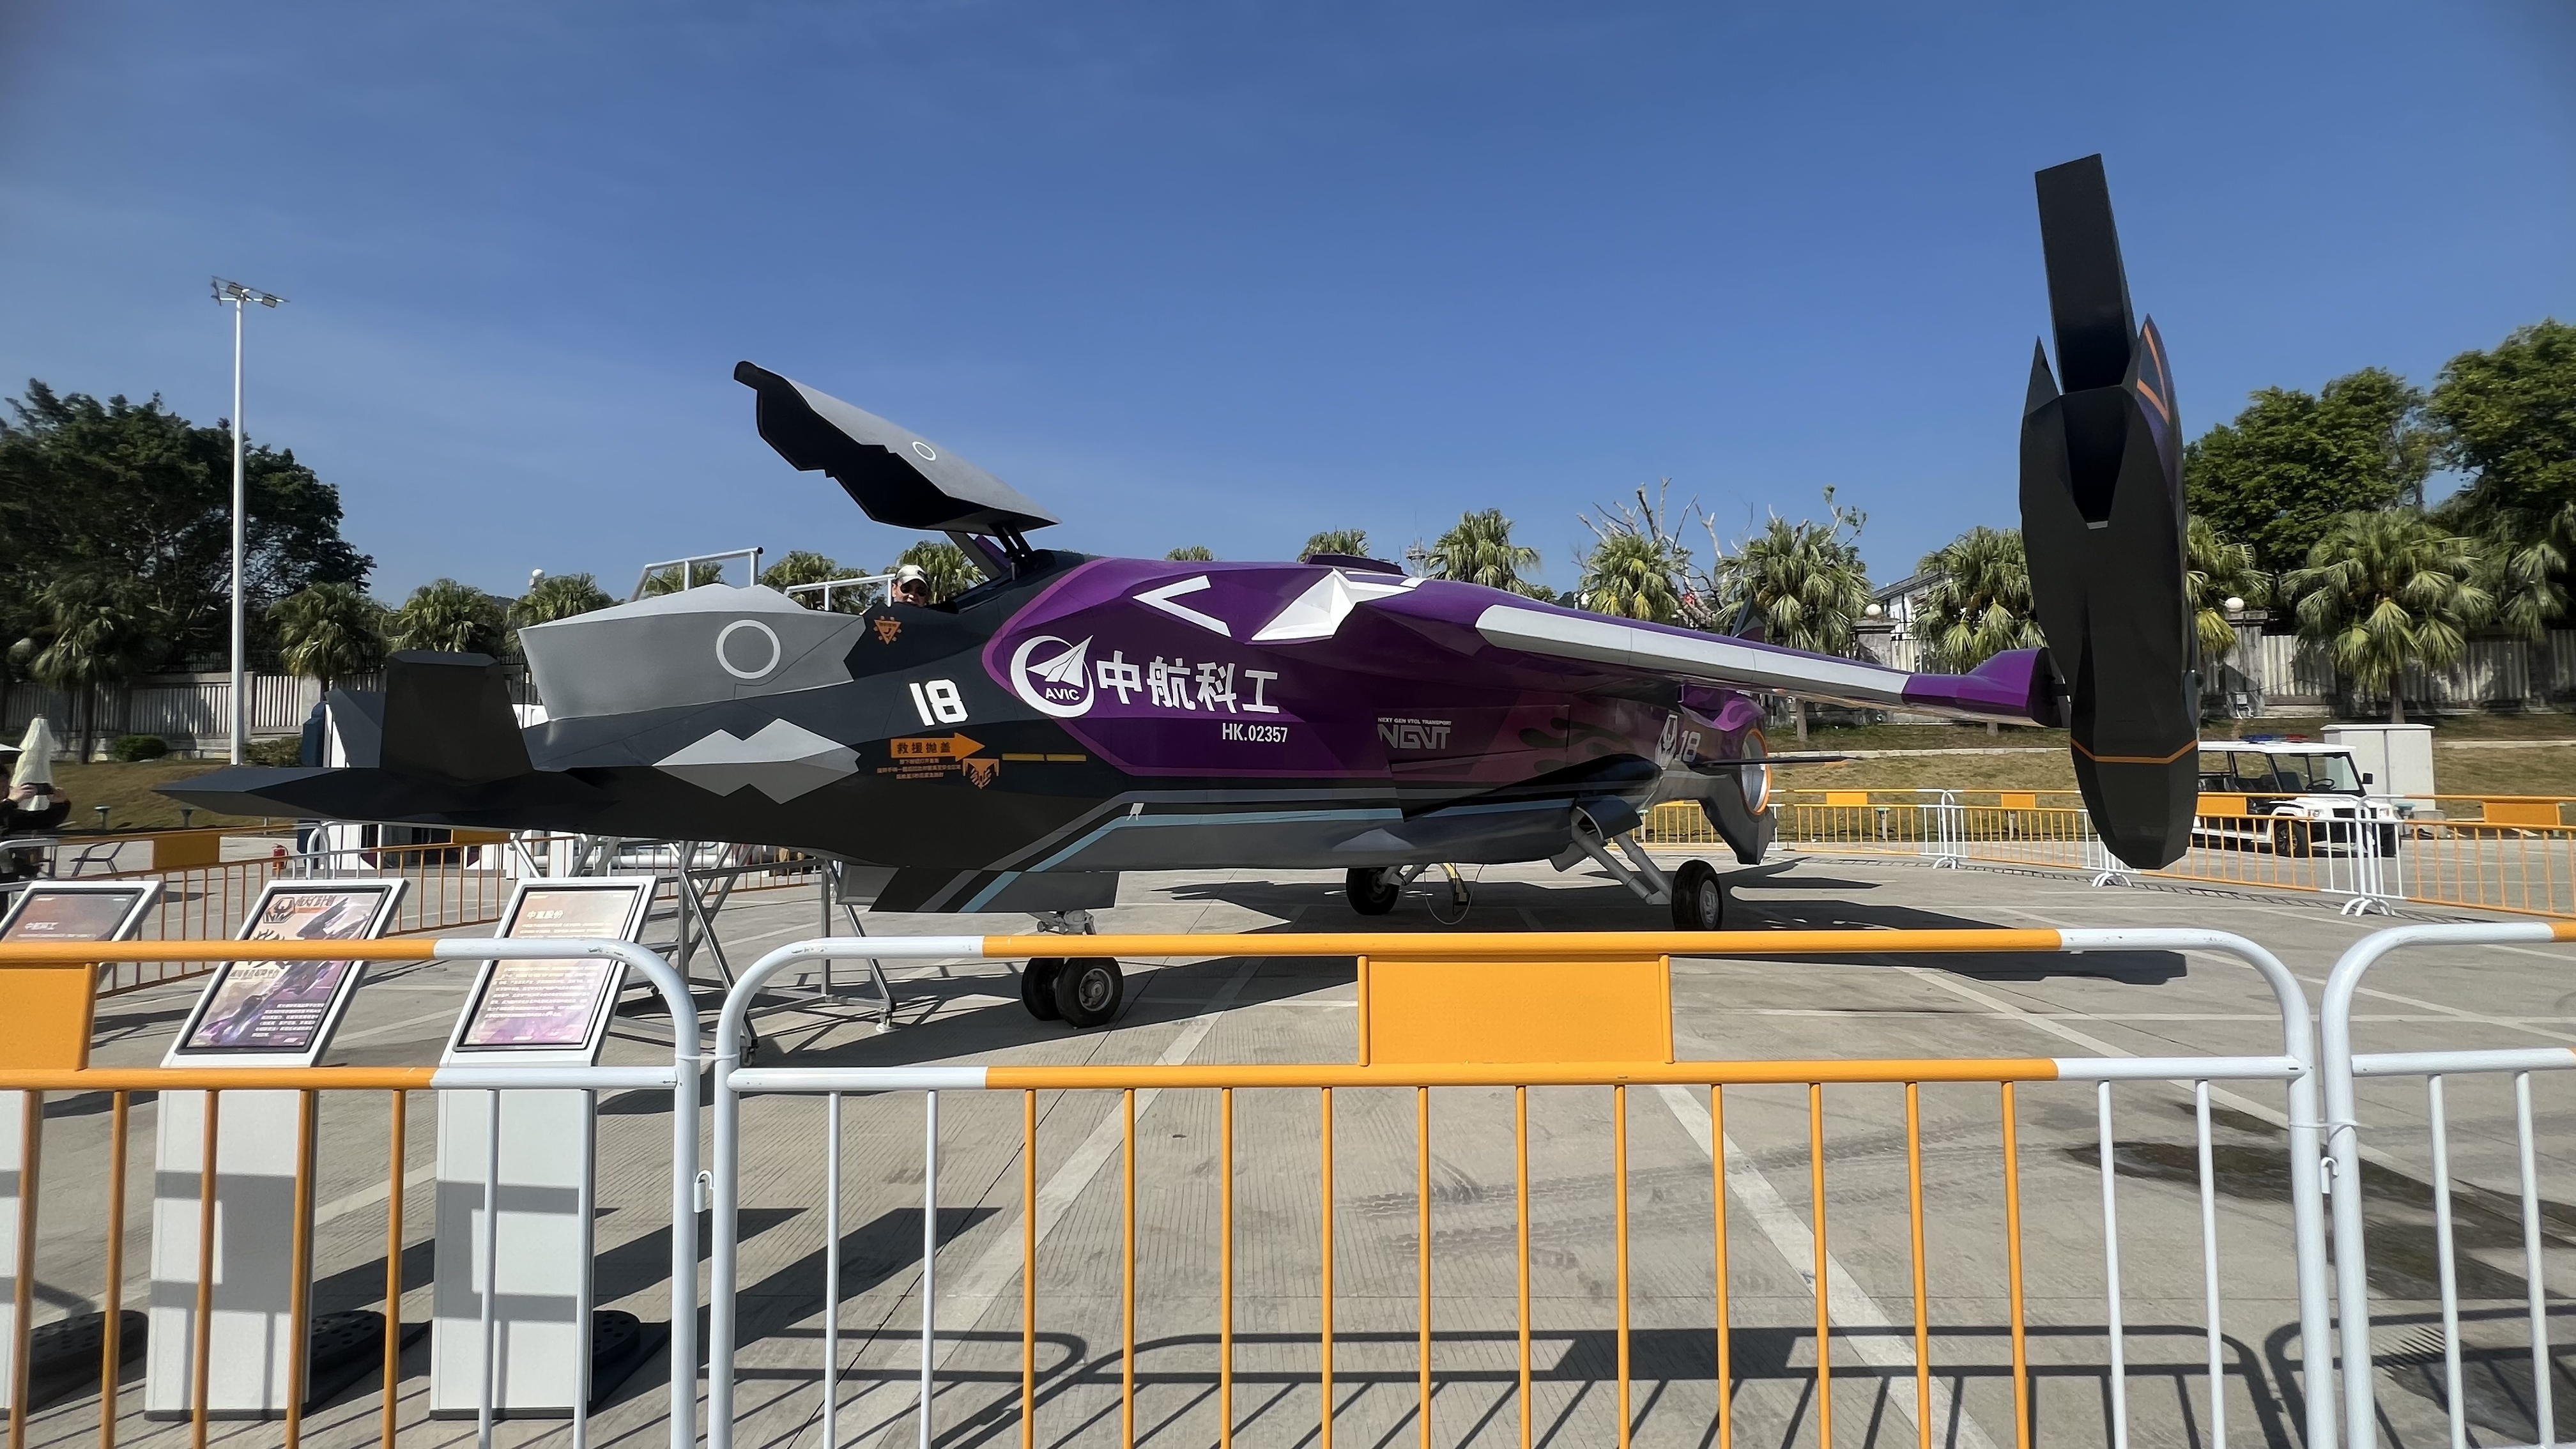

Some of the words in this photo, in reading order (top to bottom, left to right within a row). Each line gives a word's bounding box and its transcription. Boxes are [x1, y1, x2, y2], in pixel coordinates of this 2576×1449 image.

[1045, 687, 1080, 701] AVIC
[1096, 650, 1280, 714] 中航科工
[909, 679, 968, 726] 18
[1222, 723, 1288, 743] HK.02357
[1377, 724, 1451, 749] NGVT
[1675, 730, 1701, 762] 18
